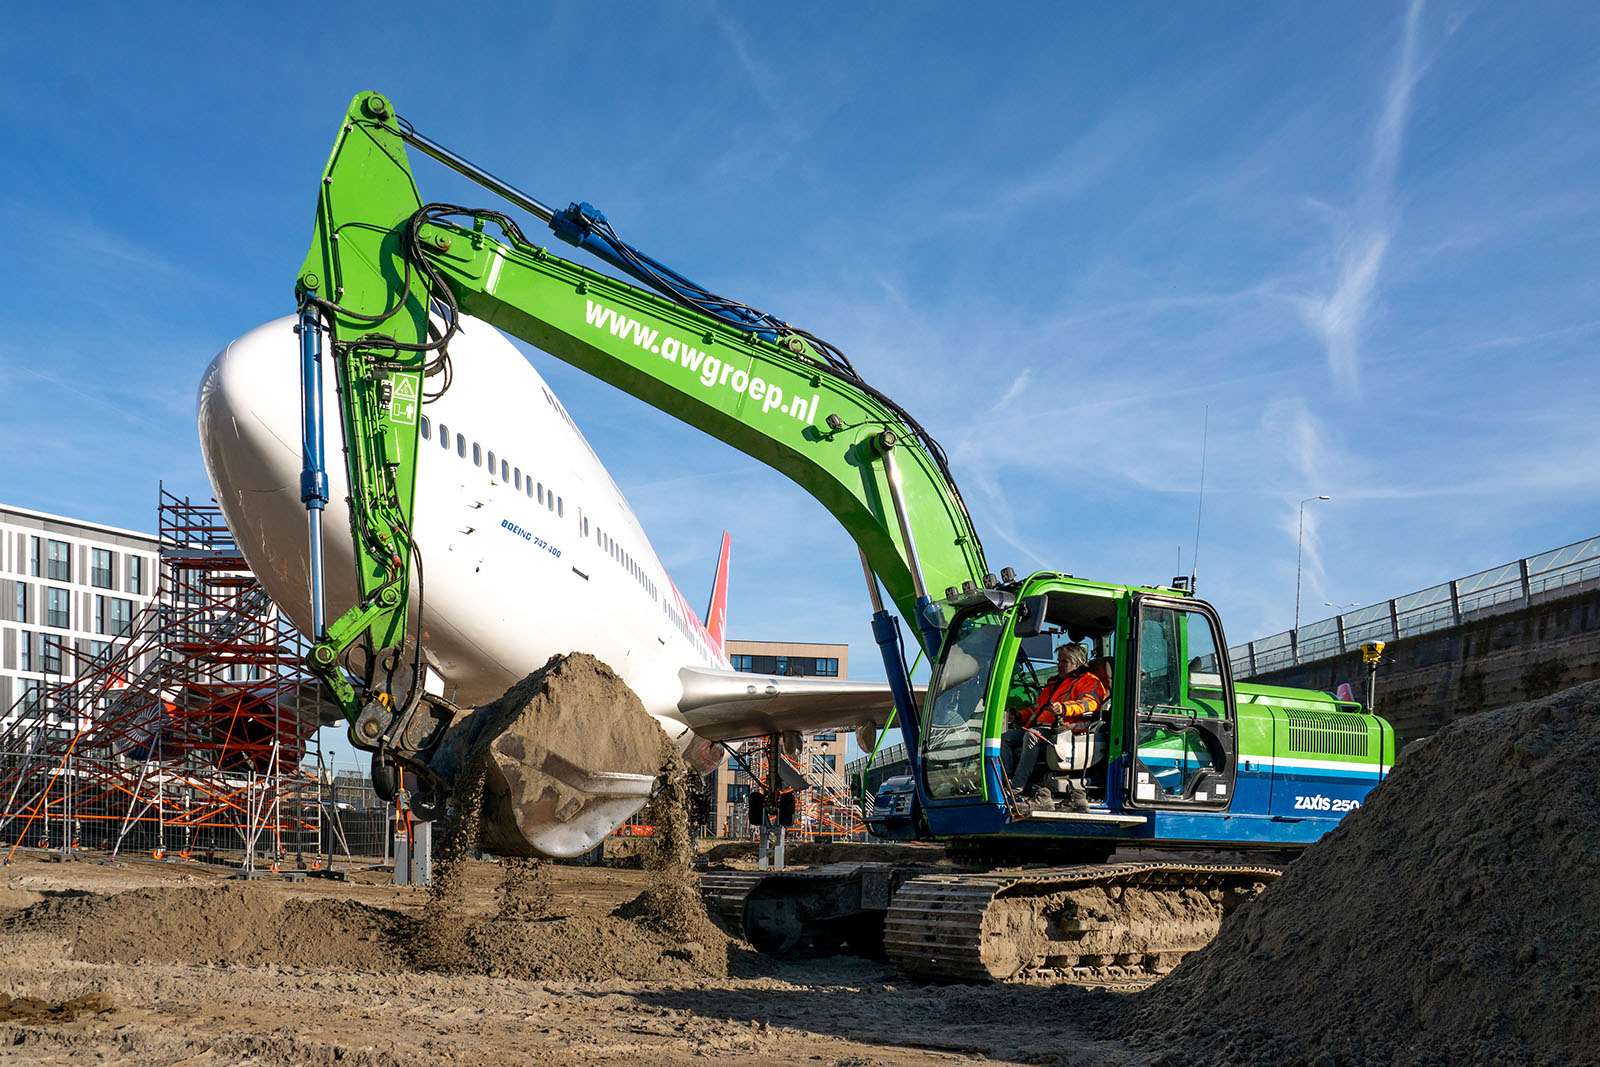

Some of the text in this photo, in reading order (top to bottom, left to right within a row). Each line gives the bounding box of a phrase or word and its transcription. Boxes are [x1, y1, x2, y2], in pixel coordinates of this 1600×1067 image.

[586, 300, 819, 424] www.awgroep.nl
[501, 519, 532, 541] BOEING
[1294, 794, 1331, 811] ZAXIS
